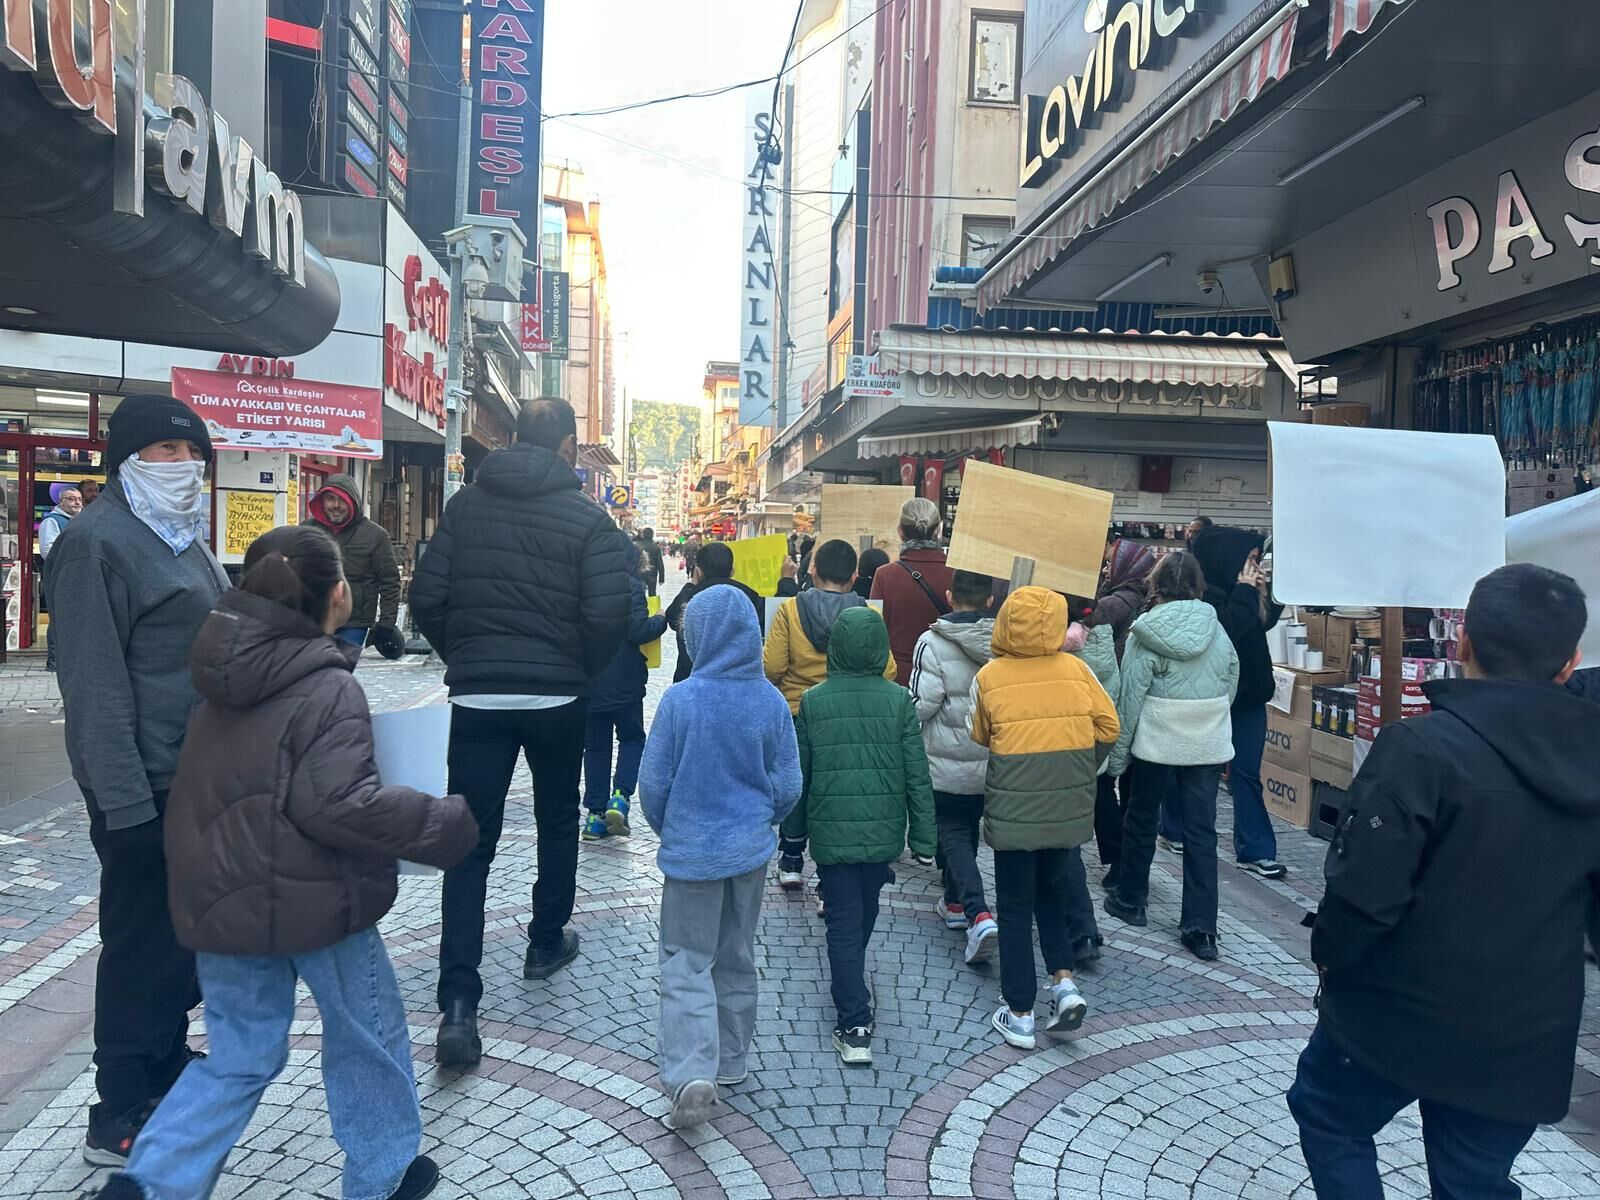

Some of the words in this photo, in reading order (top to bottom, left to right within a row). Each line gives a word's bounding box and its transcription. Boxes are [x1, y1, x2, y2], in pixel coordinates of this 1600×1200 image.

[479, 0, 535, 218] ARDEŞL
[744, 112, 774, 399] SARANLAR
[216, 353, 294, 378] AYDIN
[256, 384, 280, 395] Çelik
[282, 386, 325, 400] Kardeşler
[847, 379, 868, 388] ERKEK
[191, 393, 219, 405] TÜM
[221, 397, 285, 411] AYAKKABI
[286, 402, 302, 412] VE
[303, 404, 367, 420] ÇANTALAR
[236, 411, 281, 426] ETİKET
[284, 416, 326, 430] YARISI
[229, 520, 252, 531] BOT
[1266, 777, 1297, 804] azra
